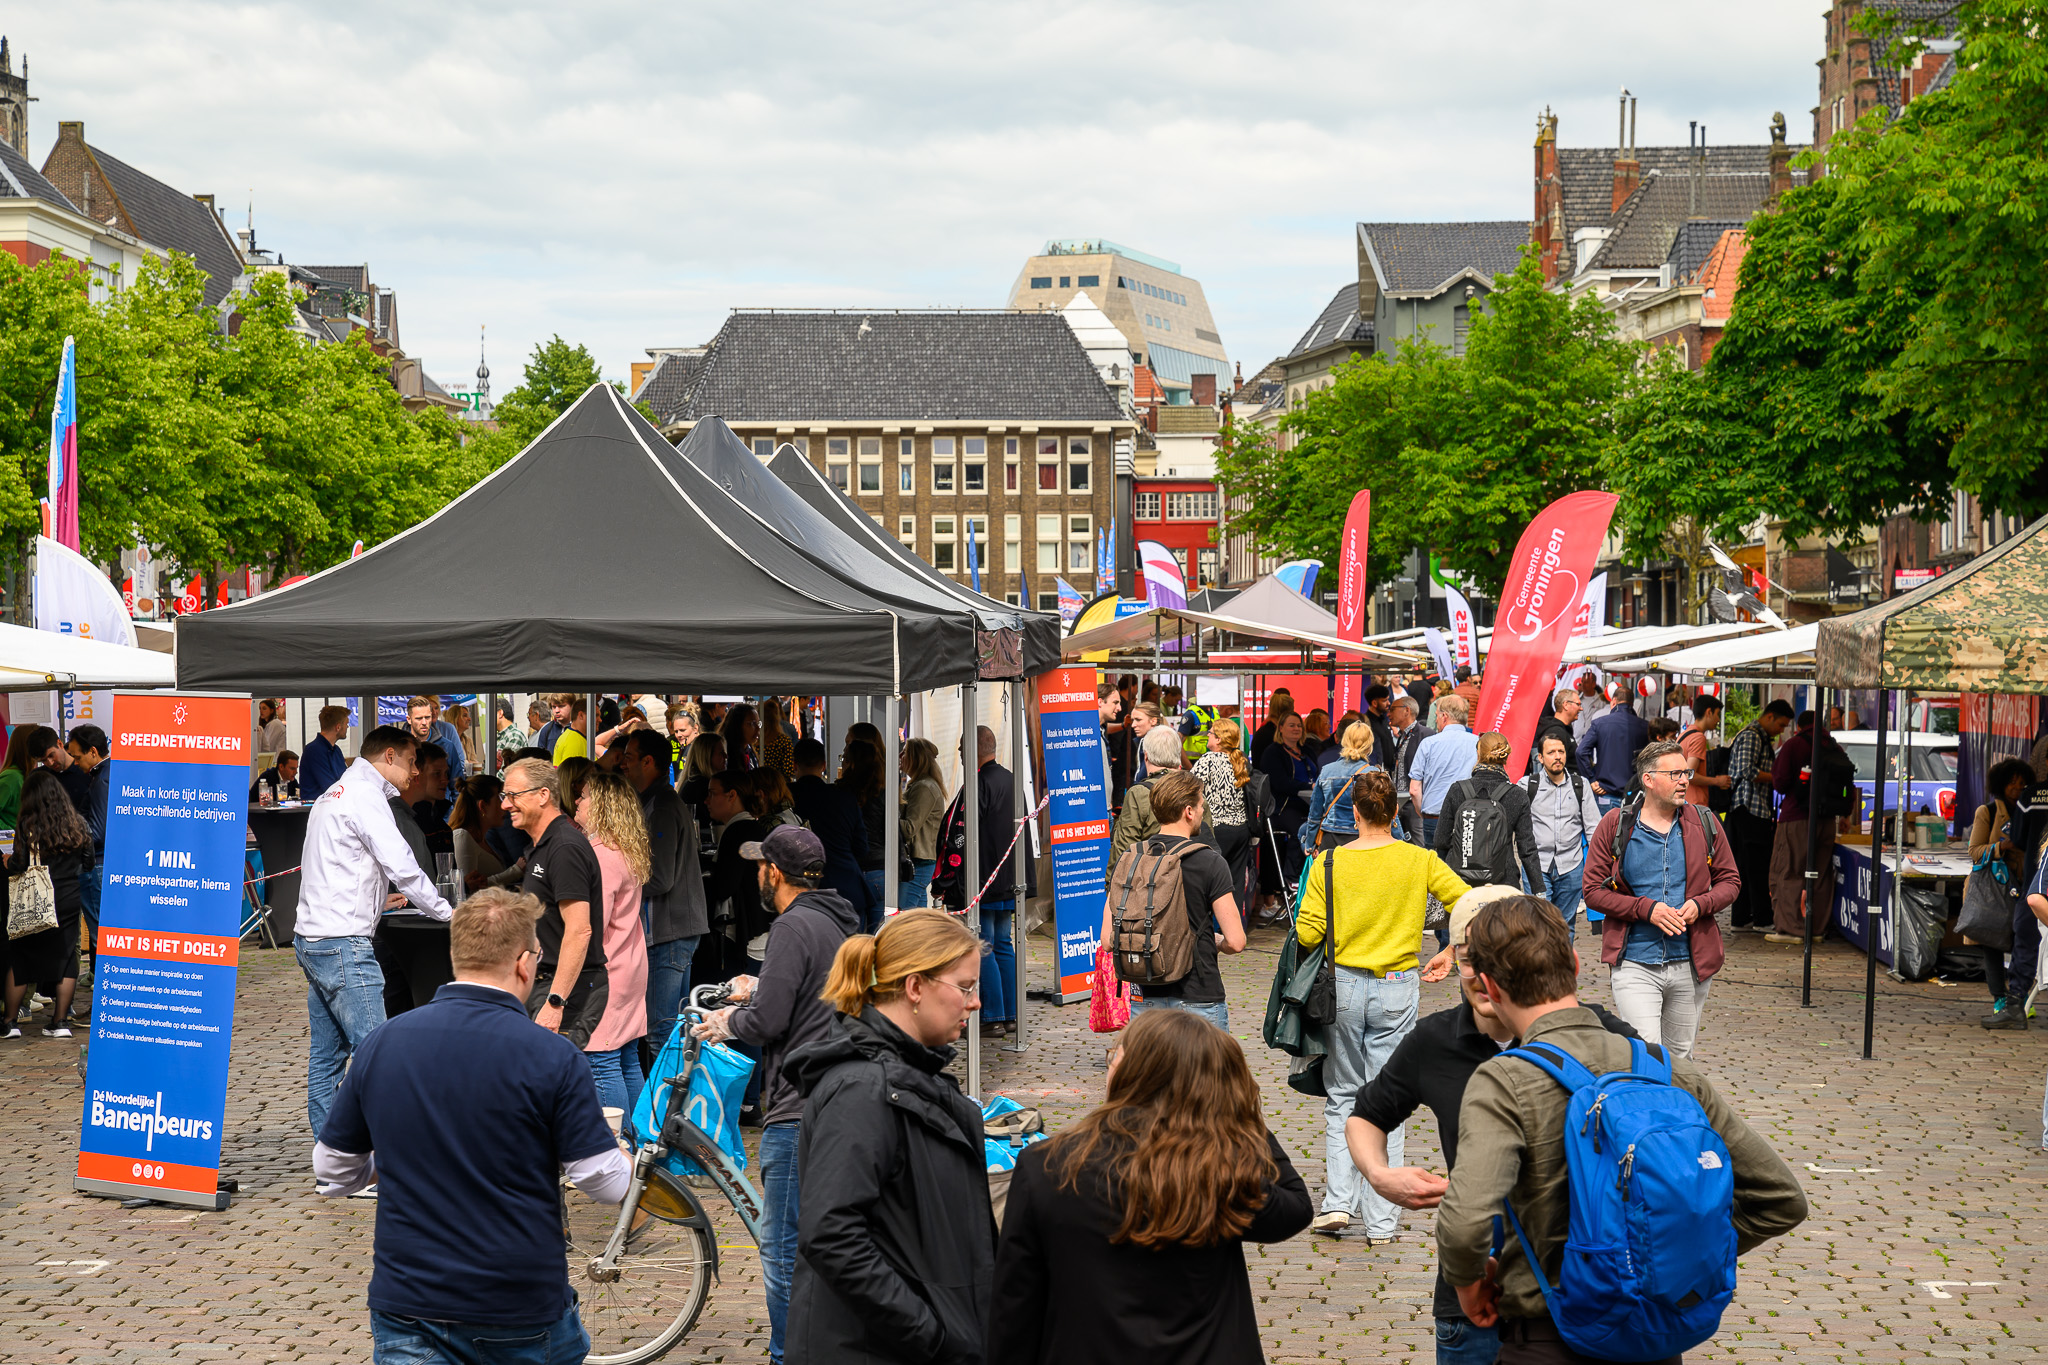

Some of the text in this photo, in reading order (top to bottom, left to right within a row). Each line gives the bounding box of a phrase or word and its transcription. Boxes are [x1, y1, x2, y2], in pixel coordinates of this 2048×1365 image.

[1346, 528, 1356, 631] Groningen
[1516, 547, 1542, 608] Gemeente
[1519, 528, 1566, 642] Groningen
[1042, 692, 1094, 703] SPEEDNETWERKEN
[120, 733, 241, 750] SPEEDNETWERKEN
[1046, 729, 1058, 738] Maak
[1058, 728, 1062, 736] in
[1062, 728, 1073, 736] korte
[1053, 740, 1079, 750] verschillende
[1080, 739, 1098, 748] bedrijven
[1062, 769, 1086, 781] 1 MIN.
[122, 785, 228, 803] Maak in korte tijd kennis
[115, 804, 236, 823] met verschillende bedrijven
[1053, 824, 1105, 839] WAT IS HET DOEL?
[145, 850, 196, 869] 1 MIN.
[110, 874, 230, 890] per gesprekspartner, hierna
[150, 894, 188, 906] wisselen
[1067, 930, 1090, 940] Noordelijke
[106, 934, 226, 957] WAT IS HET DOEL?
[1062, 926, 1102, 966] Banenbe
[111, 965, 119, 974] Op
[161, 970, 183, 979] inspiratie
[110, 982, 131, 991] Vergroot
[171, 988, 202, 997] arbeidsmarkt
[109, 998, 124, 1006] Oefen
[131, 1002, 168, 1010] communicatieve
[169, 1005, 202, 1014] vaardigheden
[108, 1015, 125, 1023] Ontdek
[134, 1017, 151, 1027] huidige
[188, 1023, 220, 1032] arbeidsmarkt
[106, 1031, 124, 1040] Ontdek
[155, 1037, 175, 1045] situaties
[176, 1039, 202, 1048] aanpakken
[93, 1090, 155, 1109] Dé Noordelijke
[91, 1092, 213, 1151] Banenbeurs
[696, 1144, 760, 1222] SPARTA
